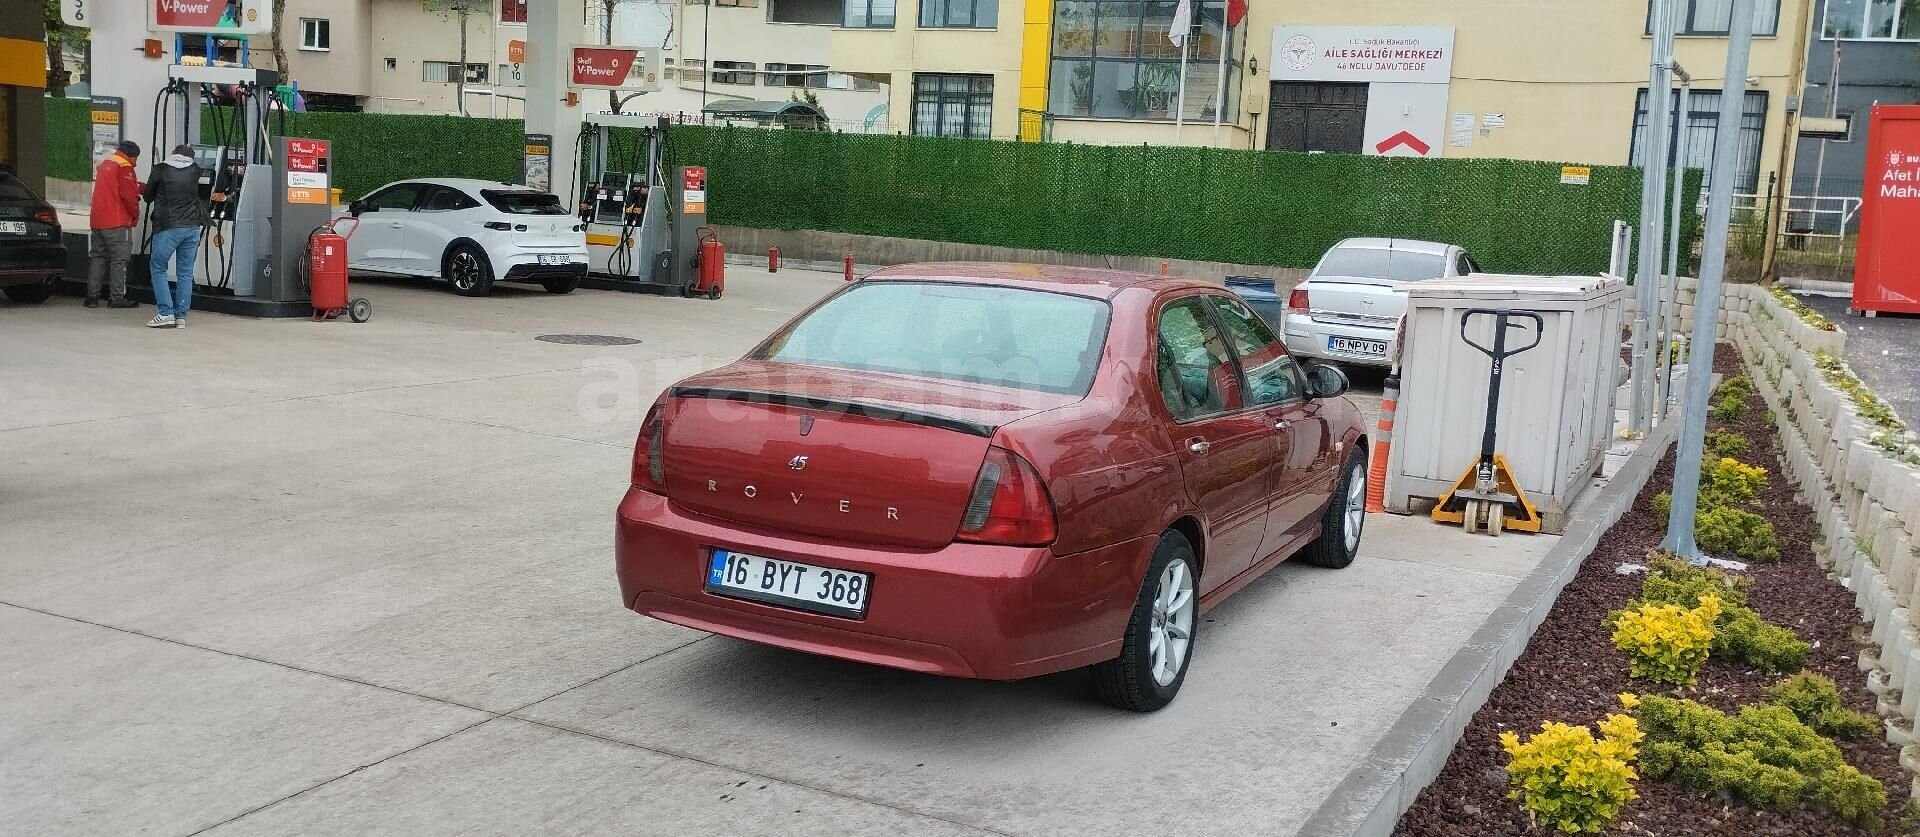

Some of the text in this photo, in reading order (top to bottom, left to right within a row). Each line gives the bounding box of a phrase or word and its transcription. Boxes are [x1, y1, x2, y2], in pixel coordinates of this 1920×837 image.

[161, 0, 209, 14] V-Power
[75, 9, 84, 20] 6
[1324, 47, 1442, 59] AİLE SAĞLIĞI MERKEZİ
[513, 63, 520, 71] 9
[577, 57, 592, 65] Shell
[511, 70, 521, 81] 10
[577, 65, 616, 77] V-Power
[1906, 155, 1920, 163] BU
[1883, 169, 1912, 181] Afet
[1880, 184, 1920, 198] Mah
[1335, 339, 1345, 349] 16
[1347, 340, 1369, 351] NPV
[1372, 343, 1385, 353] 09
[788, 455, 808, 470] 45
[708, 479, 899, 520] ROVER
[713, 554, 863, 605] TR 16 BYT 368
